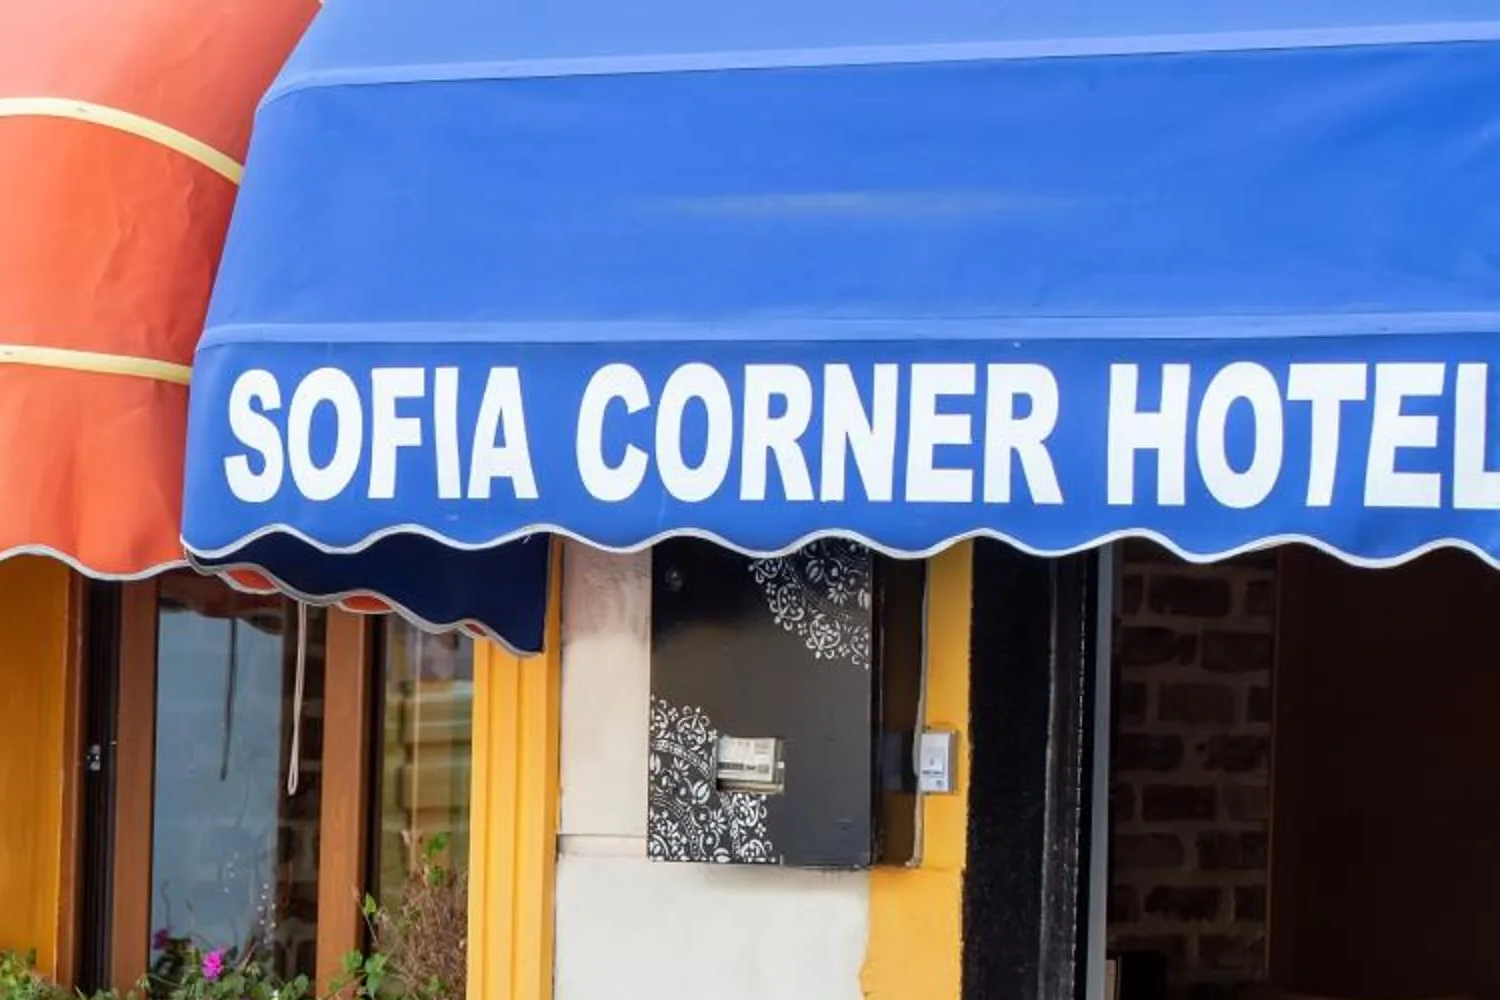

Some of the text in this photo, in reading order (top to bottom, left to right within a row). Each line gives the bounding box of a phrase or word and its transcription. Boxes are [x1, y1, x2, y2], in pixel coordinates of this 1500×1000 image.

[224, 361, 1500, 510] SOFIA CORNER HOTEL
